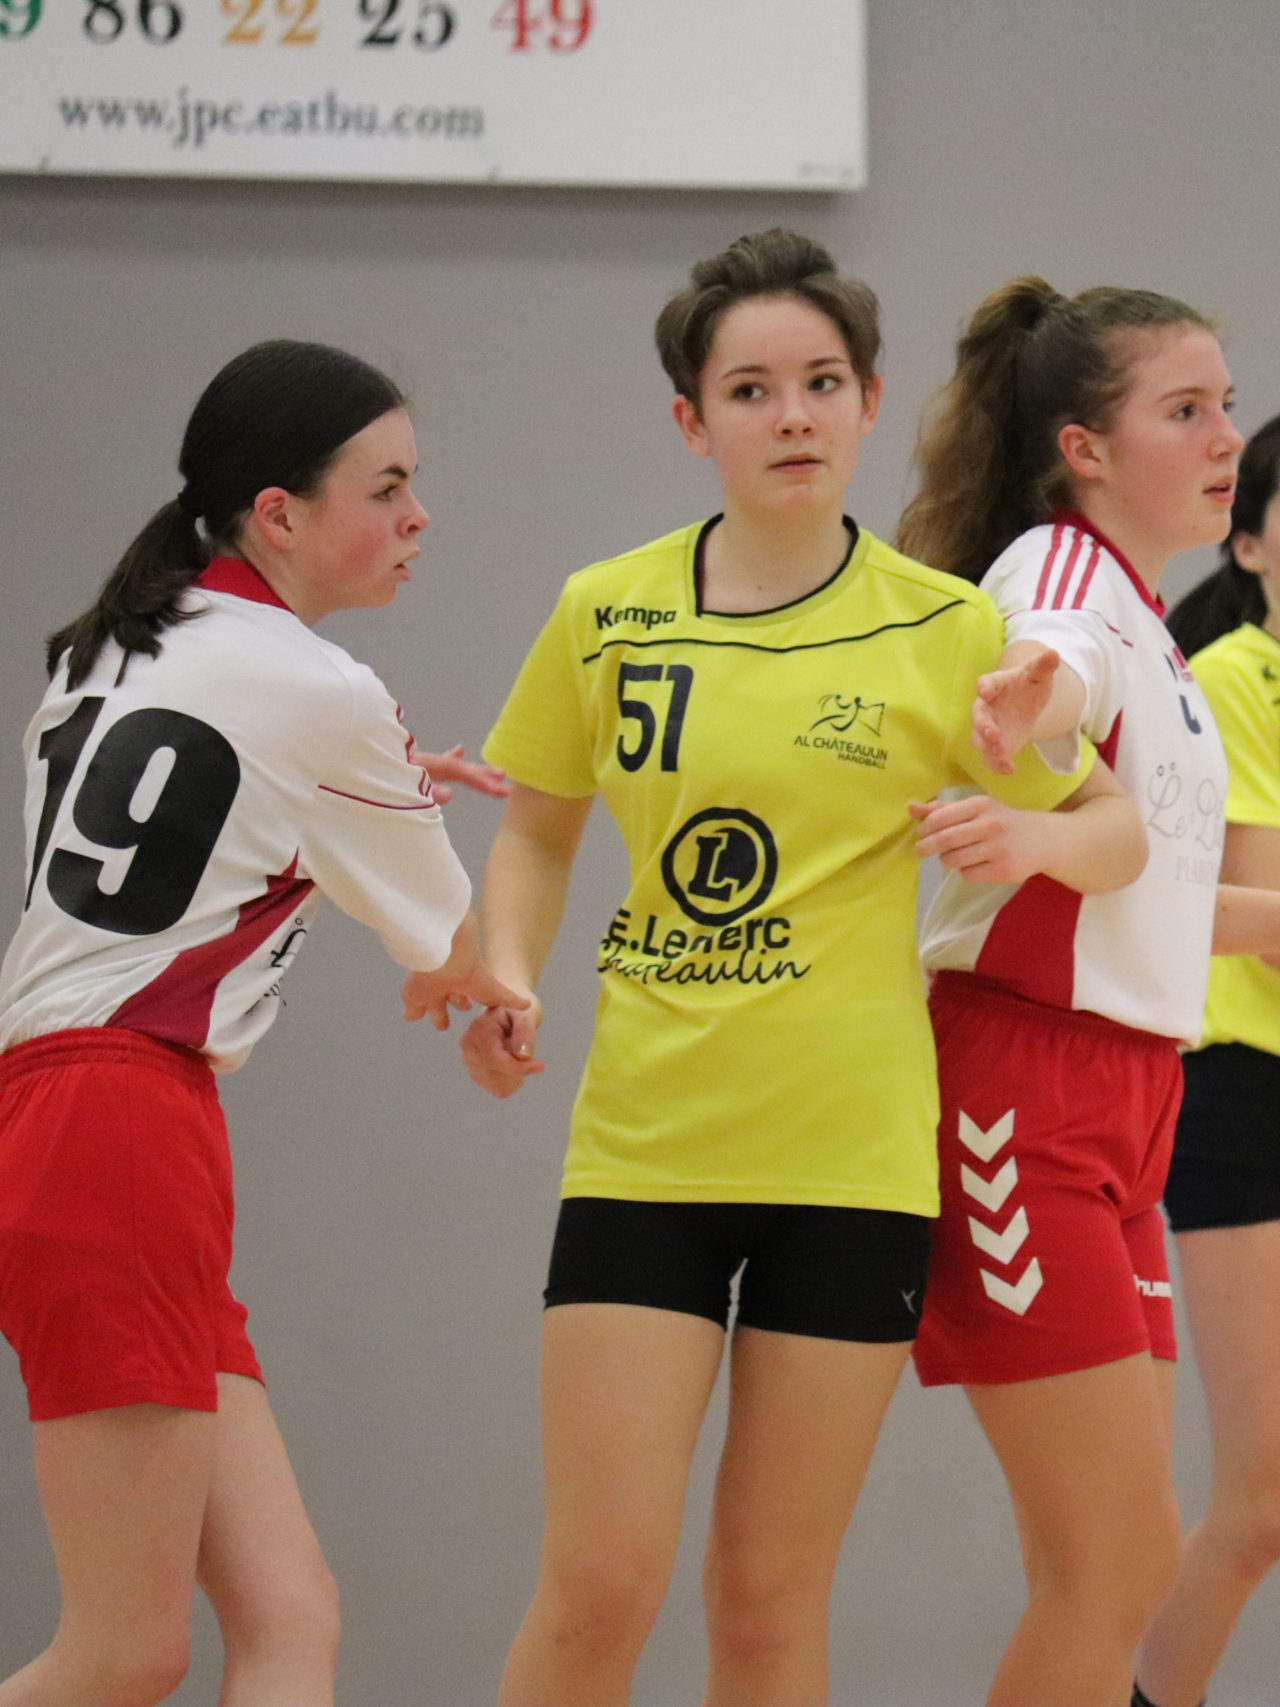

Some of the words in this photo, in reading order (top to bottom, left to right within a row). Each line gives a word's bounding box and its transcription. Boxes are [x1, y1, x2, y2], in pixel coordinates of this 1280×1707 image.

[83, 0, 184, 46] 86
[218, 0, 321, 47] 22
[355, 0, 456, 49] 25
[490, 0, 595, 54] 49
[58, 84, 486, 148] www.jpc.eatbu.com
[594, 605, 678, 631] Kempa
[616, 661, 694, 773] 57
[793, 734, 811, 749] AL
[836, 752, 887, 771] HANDBALL
[24, 695, 242, 937] 19
